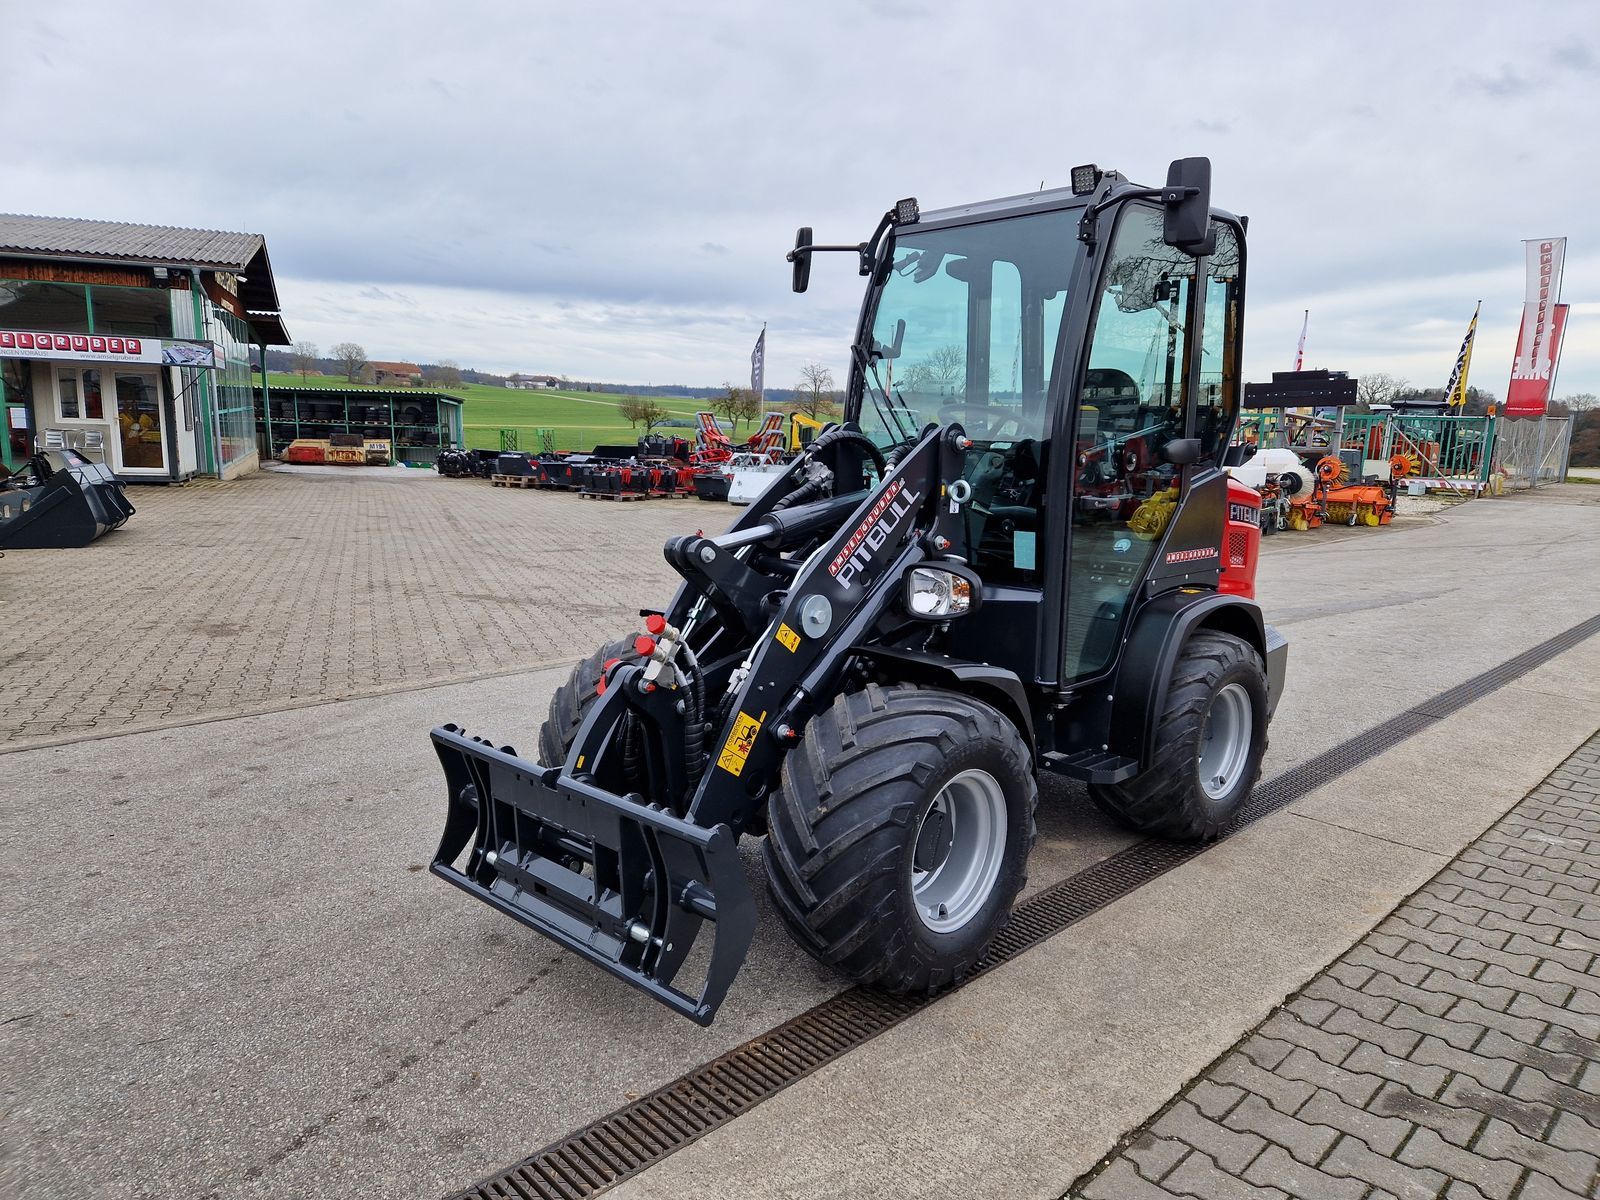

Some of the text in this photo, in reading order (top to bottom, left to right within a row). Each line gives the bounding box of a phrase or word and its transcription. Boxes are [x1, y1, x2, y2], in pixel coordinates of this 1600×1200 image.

[0, 332, 141, 354] ELGRUBER
[80, 352, 141, 361] www.amselgruber.at
[1230, 503, 1261, 527] PITBUL
[835, 488, 920, 590] PITBULL
